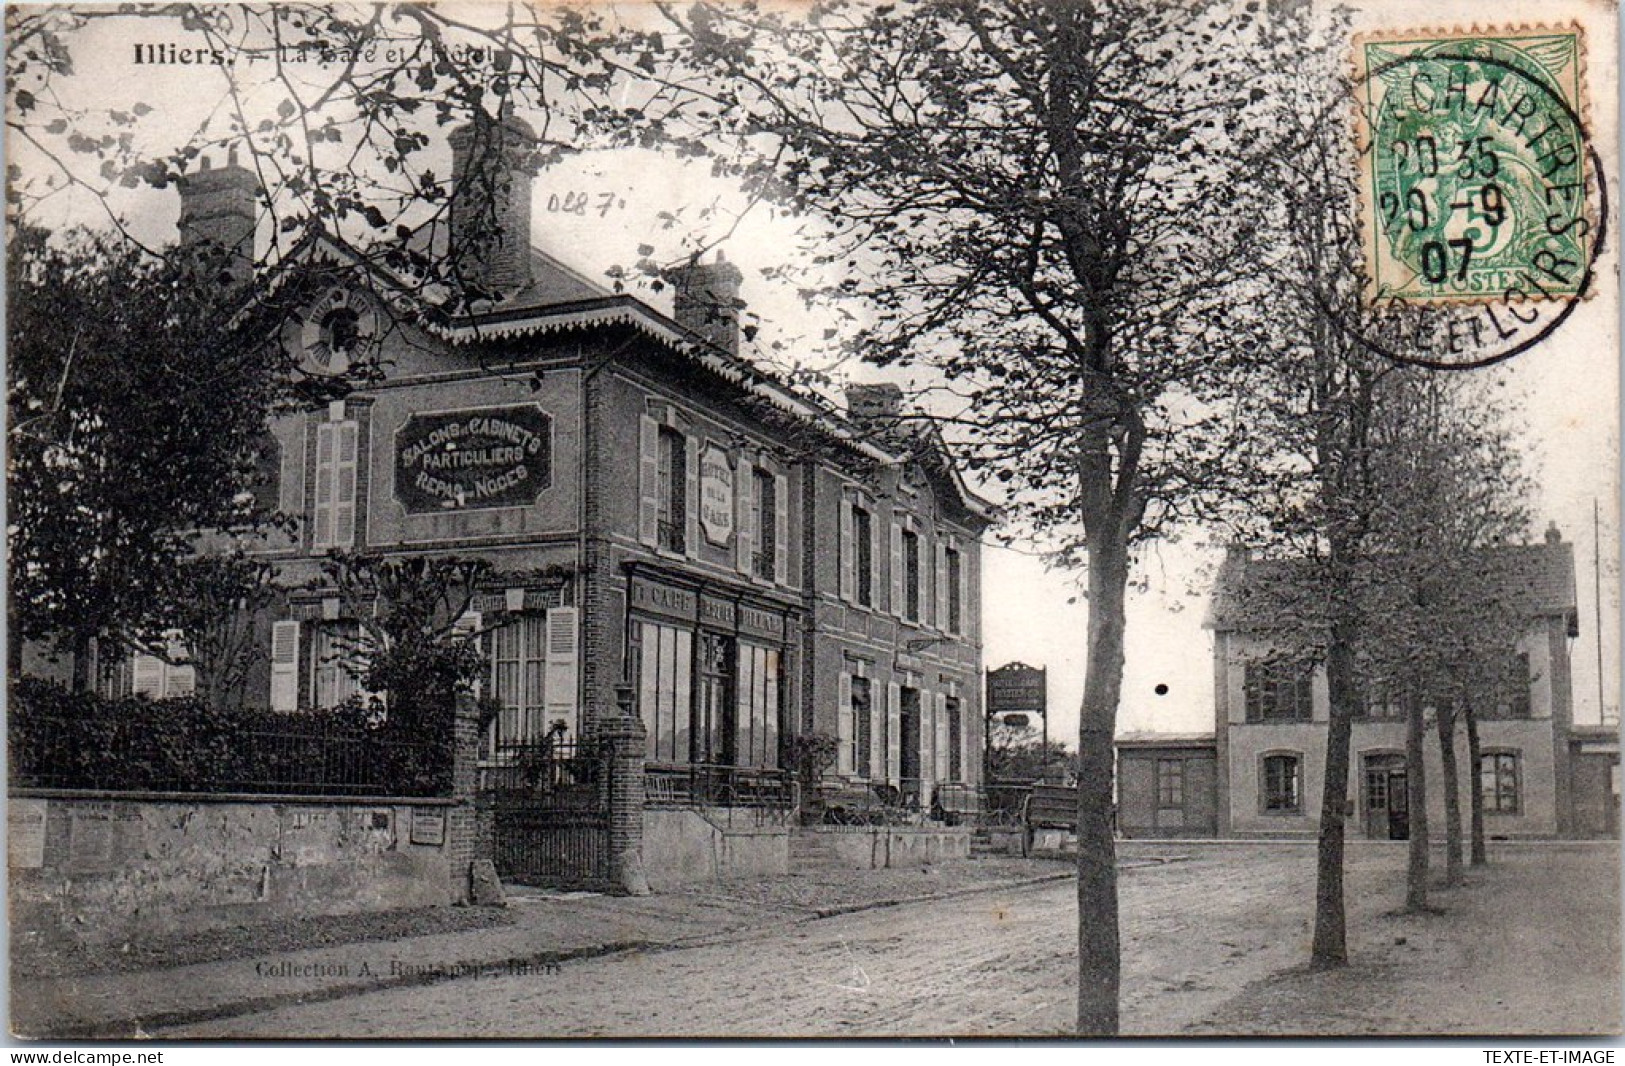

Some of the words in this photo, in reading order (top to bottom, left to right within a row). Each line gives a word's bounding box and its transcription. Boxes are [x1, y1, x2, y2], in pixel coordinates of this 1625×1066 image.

[1411, 69, 1590, 238] CHARTRES
[1457, 136, 1499, 180] 35
[1422, 238, 1473, 283] 07
[402, 423, 460, 468] SALONS
[469, 417, 541, 454] CABINETS
[423, 446, 524, 470] PARTICULIERS
[415, 471, 463, 498] REPAS
[475, 465, 528, 498] NOCES
